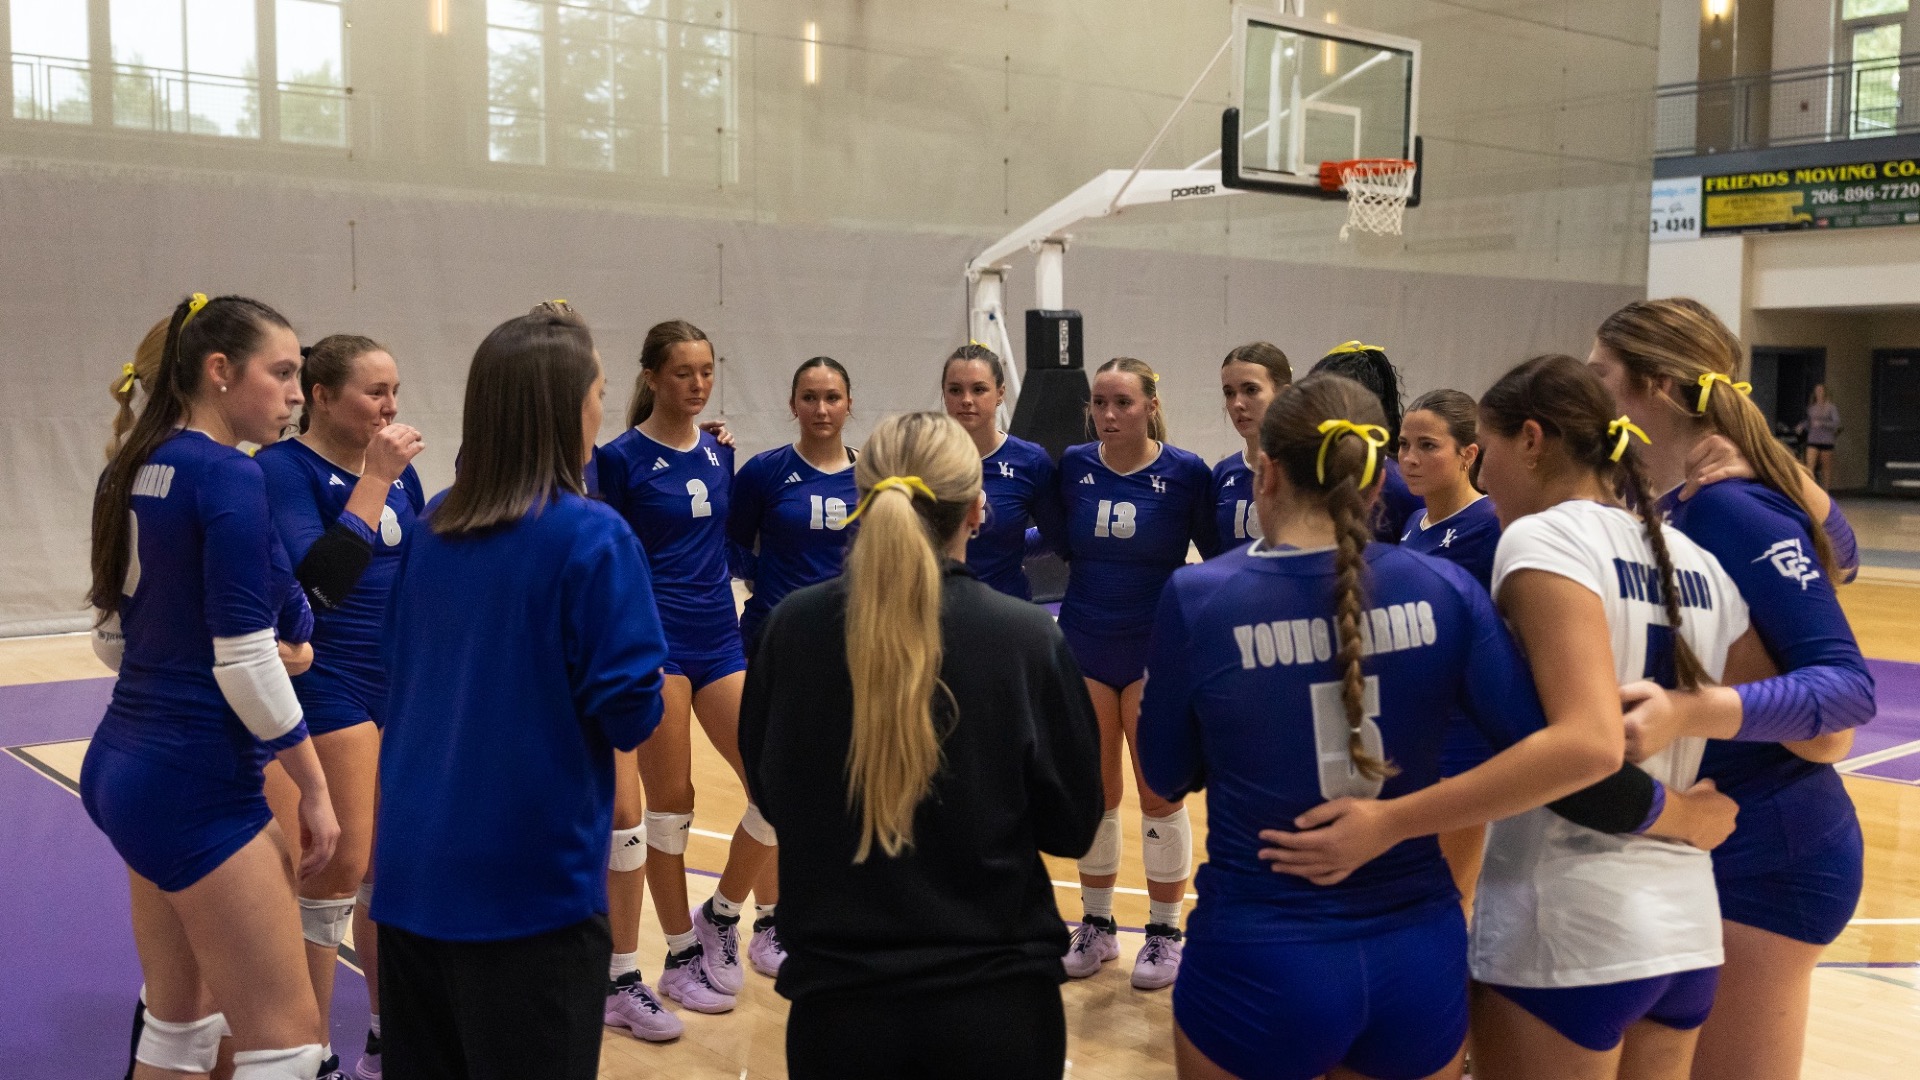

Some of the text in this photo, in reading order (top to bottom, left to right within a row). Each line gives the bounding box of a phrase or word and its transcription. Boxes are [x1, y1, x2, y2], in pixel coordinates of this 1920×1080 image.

[1705, 171, 1790, 192] FRIENDS
[1795, 163, 1877, 184] MOVING
[1811, 182, 1920, 204] 706-896-7720
[685, 478, 713, 519] 2
[380, 504, 402, 547] 8
[1094, 499, 1137, 540] 13
[1233, 617, 1332, 670] YOUNG
